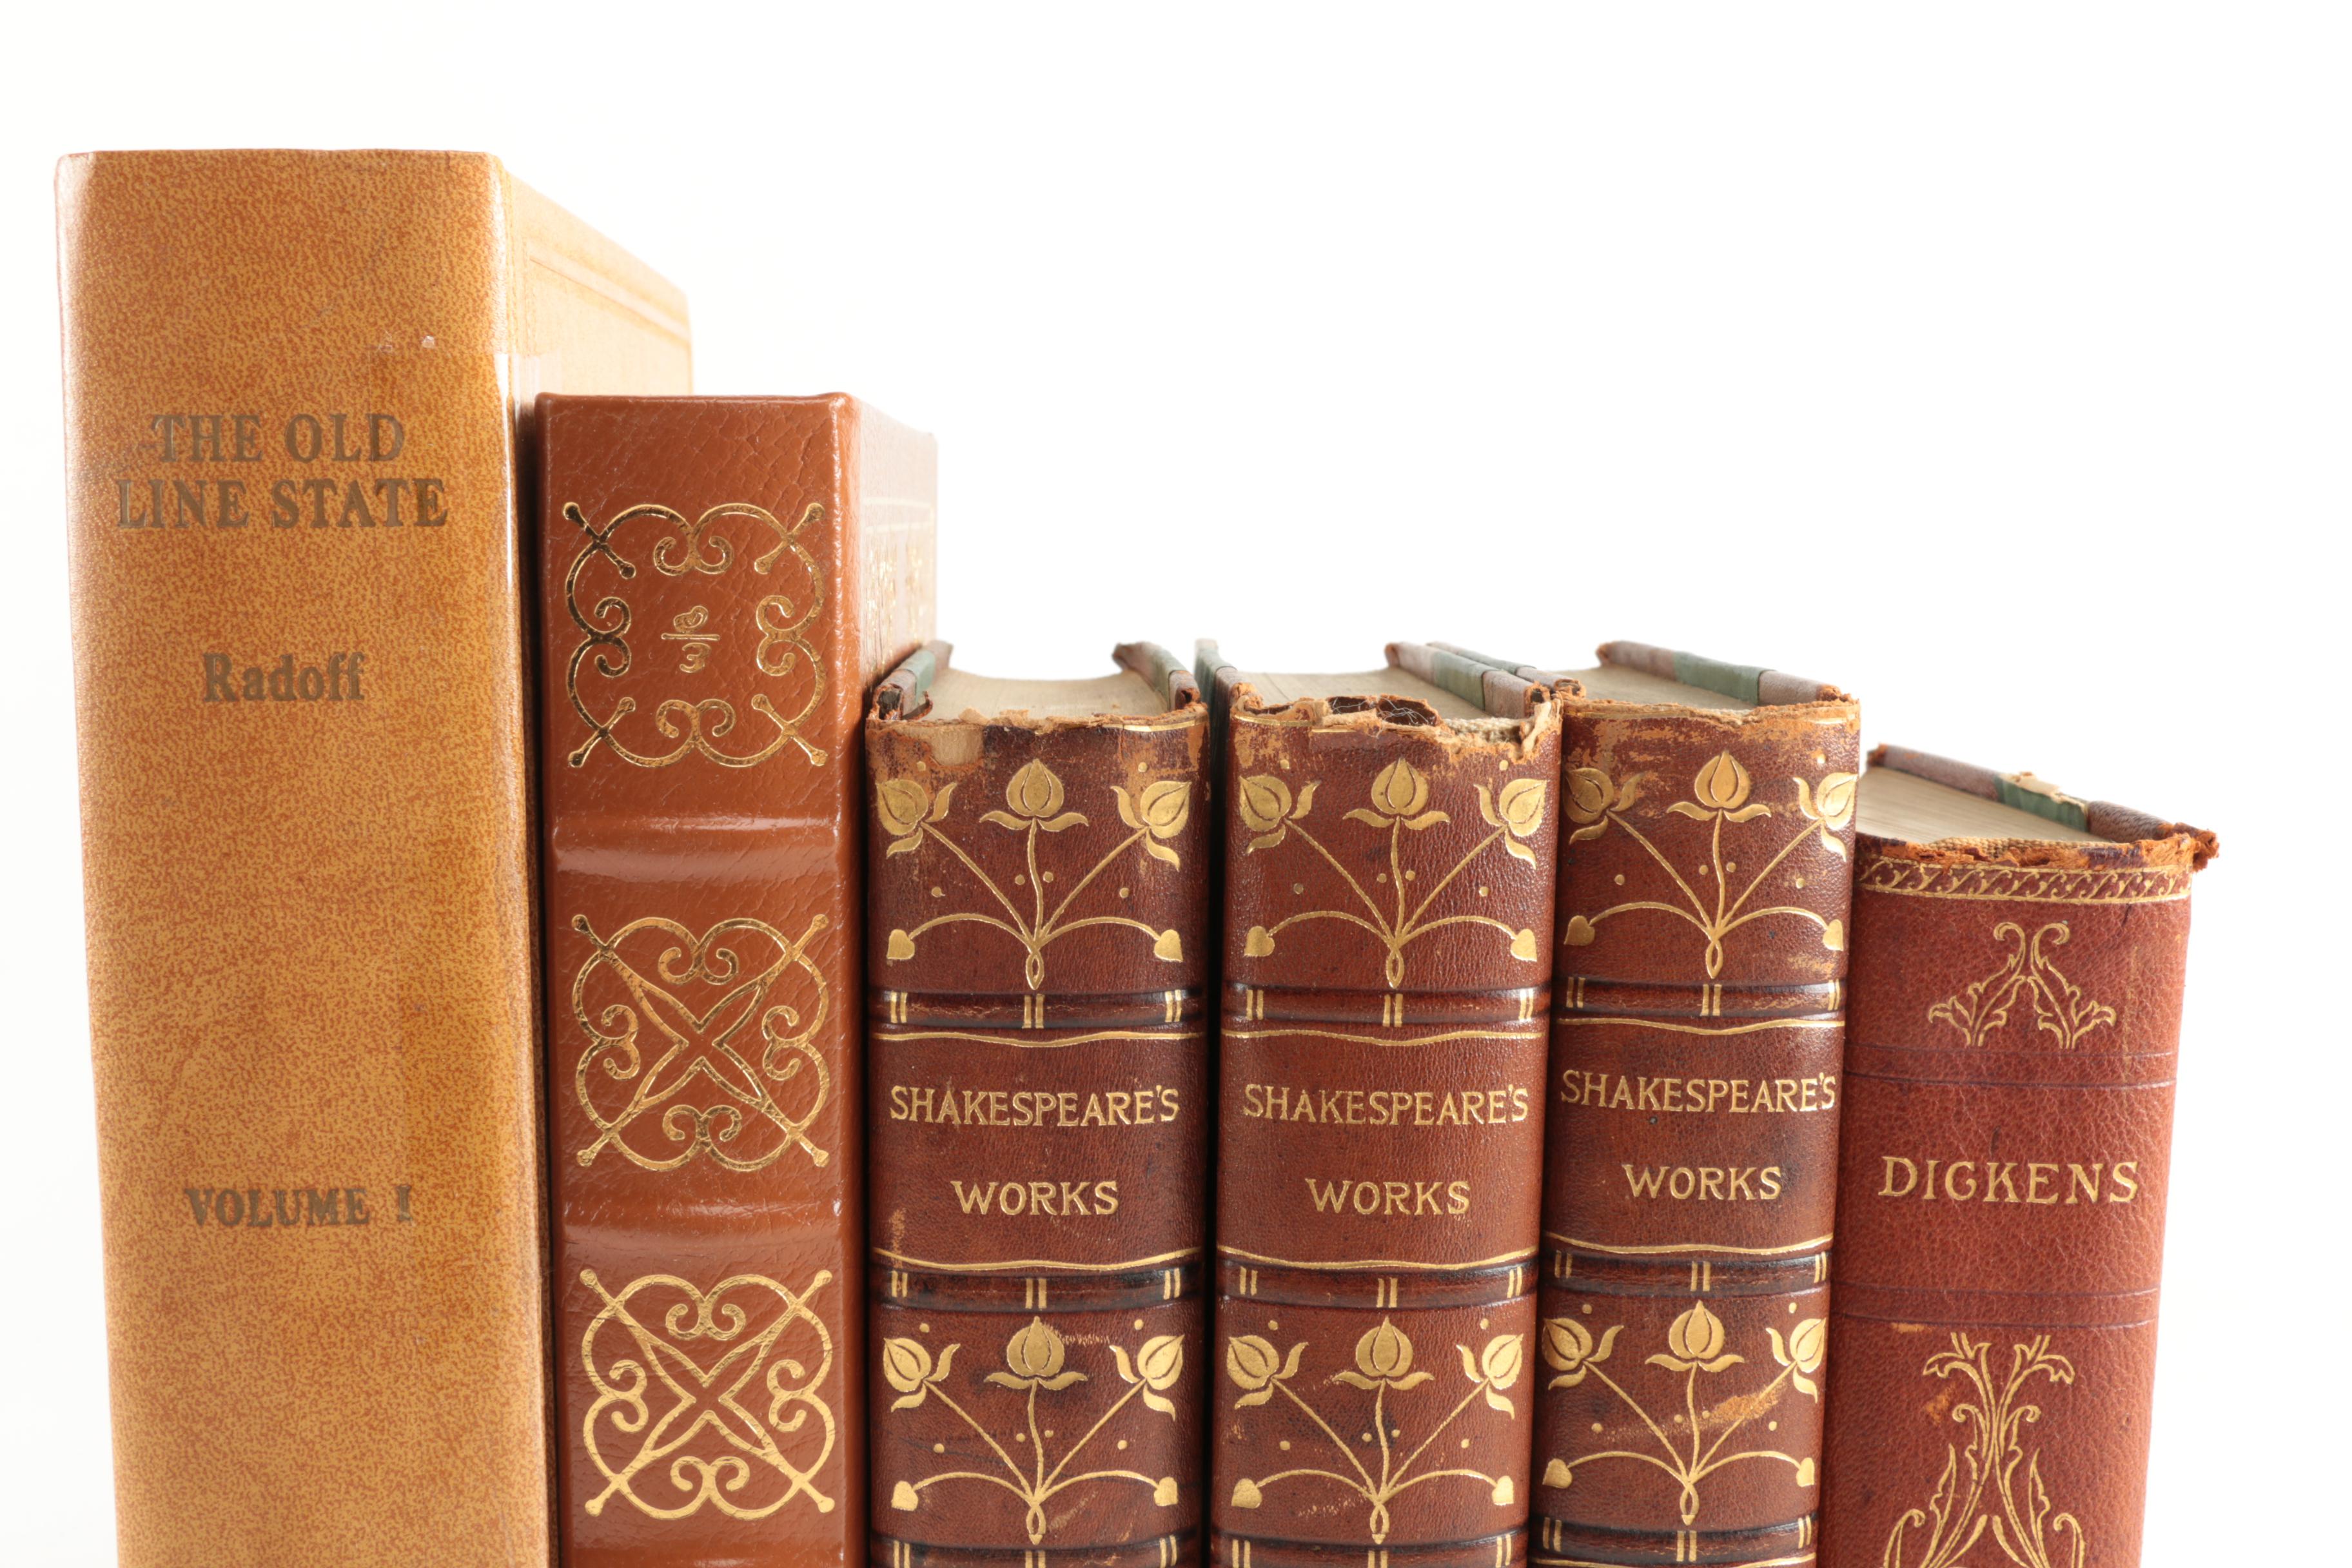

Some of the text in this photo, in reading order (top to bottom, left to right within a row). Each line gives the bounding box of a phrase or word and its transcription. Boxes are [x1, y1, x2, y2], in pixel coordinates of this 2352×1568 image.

[152, 413, 406, 463] THE OLD
[117, 478, 449, 529] LINE STATE
[202, 651, 366, 702] Radoff
[890, 1084, 1181, 1126] SHAKESPEARE'S
[1242, 1084, 1529, 1126] SHAKESPEARE'S
[1560, 1069, 1836, 1113] SHAKESPEARE'S
[950, 1181, 1119, 1216] WORKS
[1305, 1178, 1471, 1215] WORKS
[1621, 1164, 1783, 1200] WORKS
[183, 1184, 414, 1227] VOLUME I
